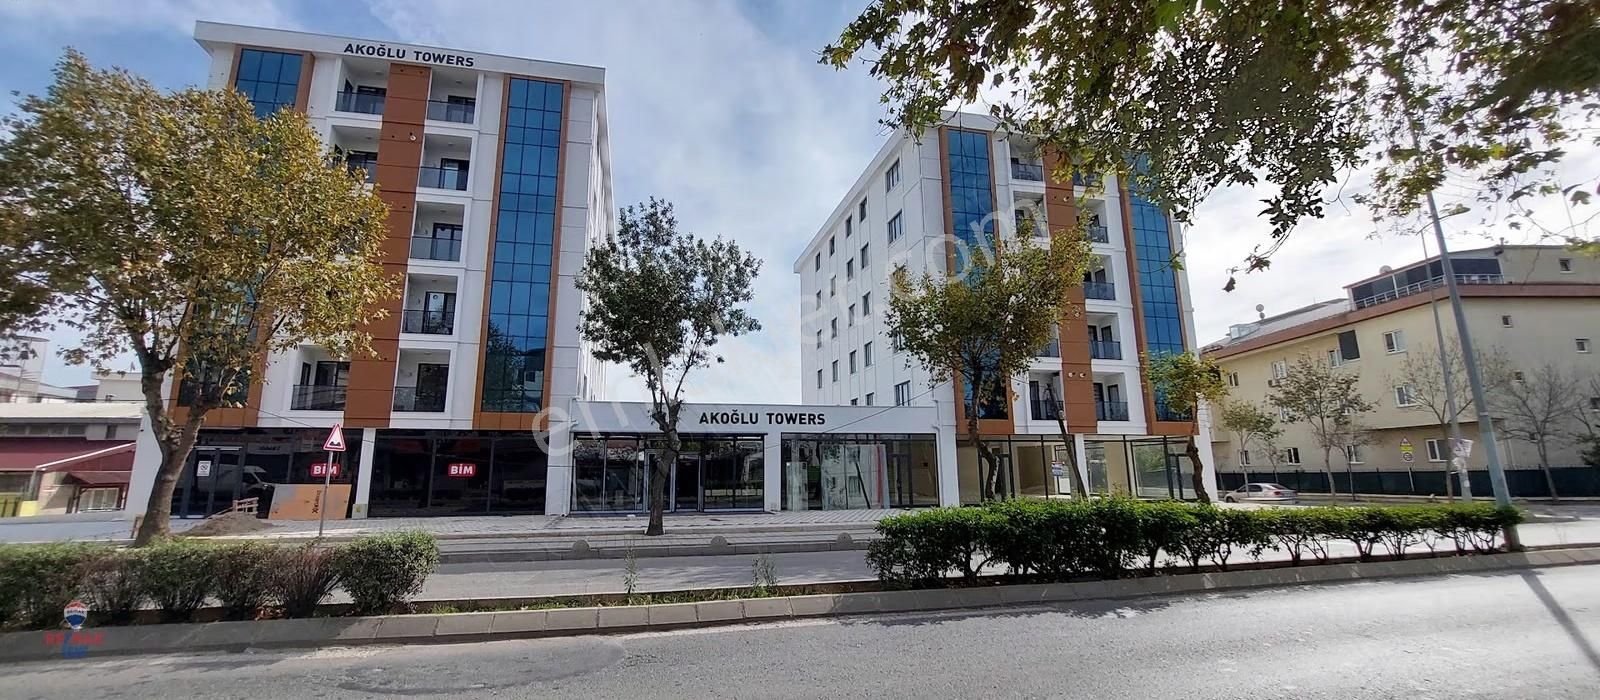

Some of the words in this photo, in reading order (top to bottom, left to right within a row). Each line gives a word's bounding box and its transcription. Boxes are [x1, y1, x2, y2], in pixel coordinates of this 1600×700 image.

[344, 43, 406, 59] AKOĞLU
[413, 51, 474, 67] TOWERS
[699, 409, 759, 425] AKOĞLU
[766, 412, 826, 425] TOWERS
